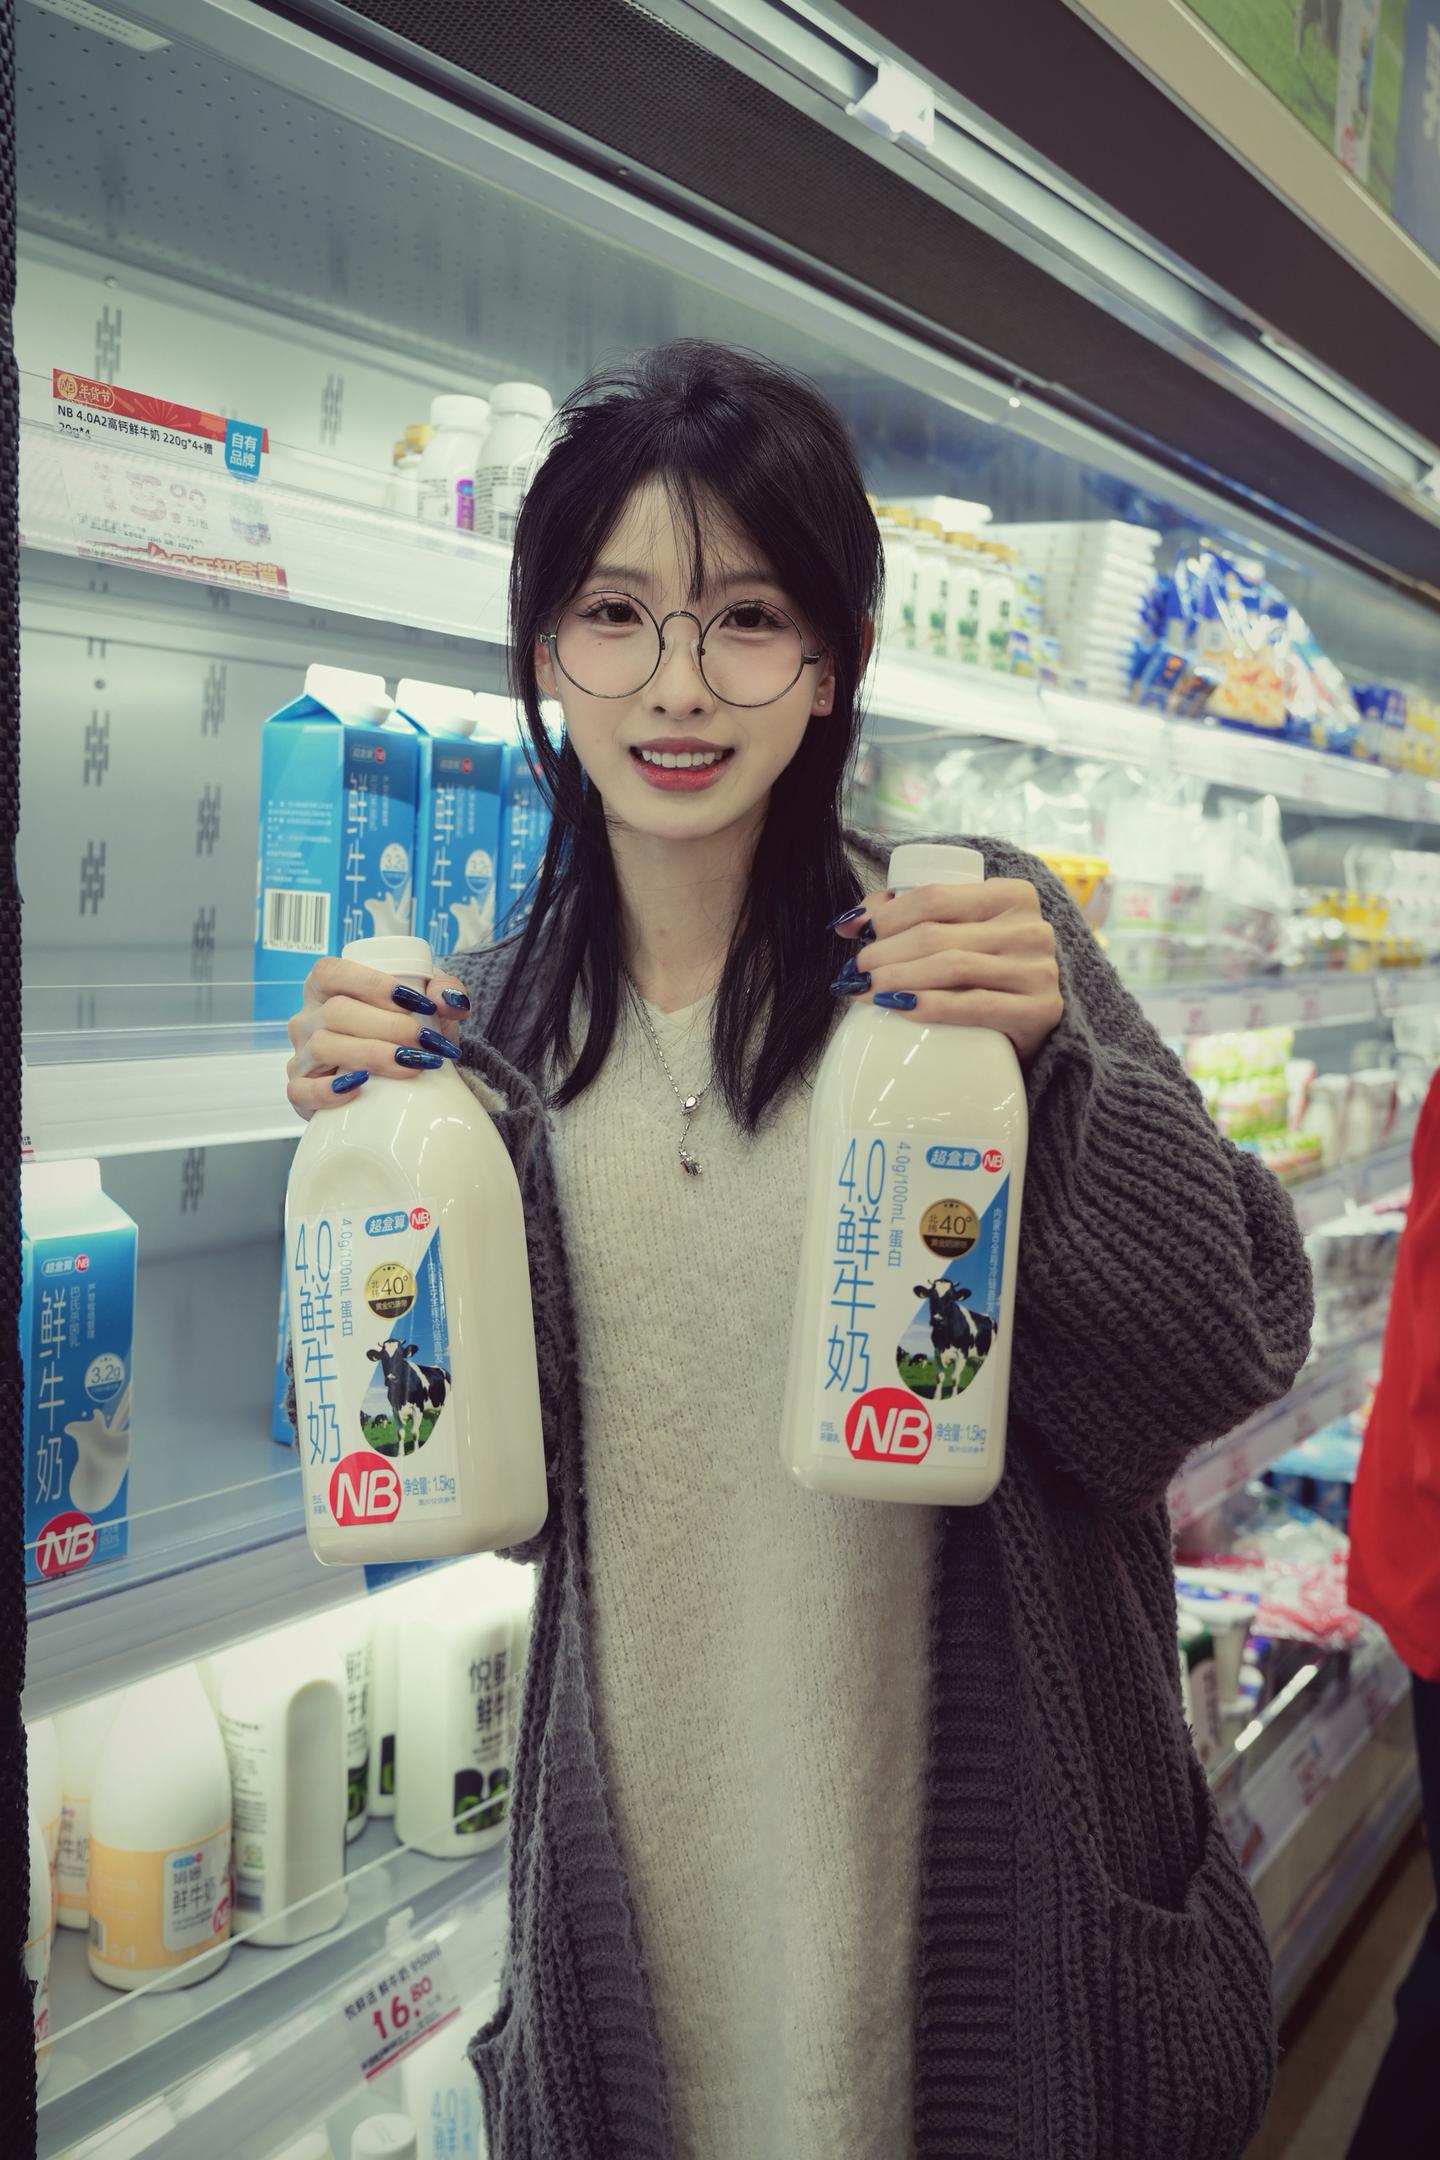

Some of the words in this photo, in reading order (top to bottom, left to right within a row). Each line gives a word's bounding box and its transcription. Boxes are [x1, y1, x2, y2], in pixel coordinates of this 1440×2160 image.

[79, 384, 111, 404] 年货节
[57, 405, 74, 418] NB
[76, 411, 160, 442] 4.0A2高钙鲜牛奶
[231, 432, 257, 452] 自有
[230, 449, 256, 469] 品牌
[930, 1150, 977, 1168] 超盒算
[984, 1154, 1004, 1169] NB
[890, 1140, 911, 1226] 4.0g/100mL
[369, 1214, 406, 1234] 超盒算
[411, 1211, 430, 1226] NB
[76, 1257, 90, 1270] NB
[338, 1218, 353, 1297] 4.0g/100mL
[35, 1287, 66, 1505] 鲜牛奶
[851, 1405, 930, 1457] NB
[336, 1469, 400, 1519] NB
[42, 1522, 95, 1571] NB
